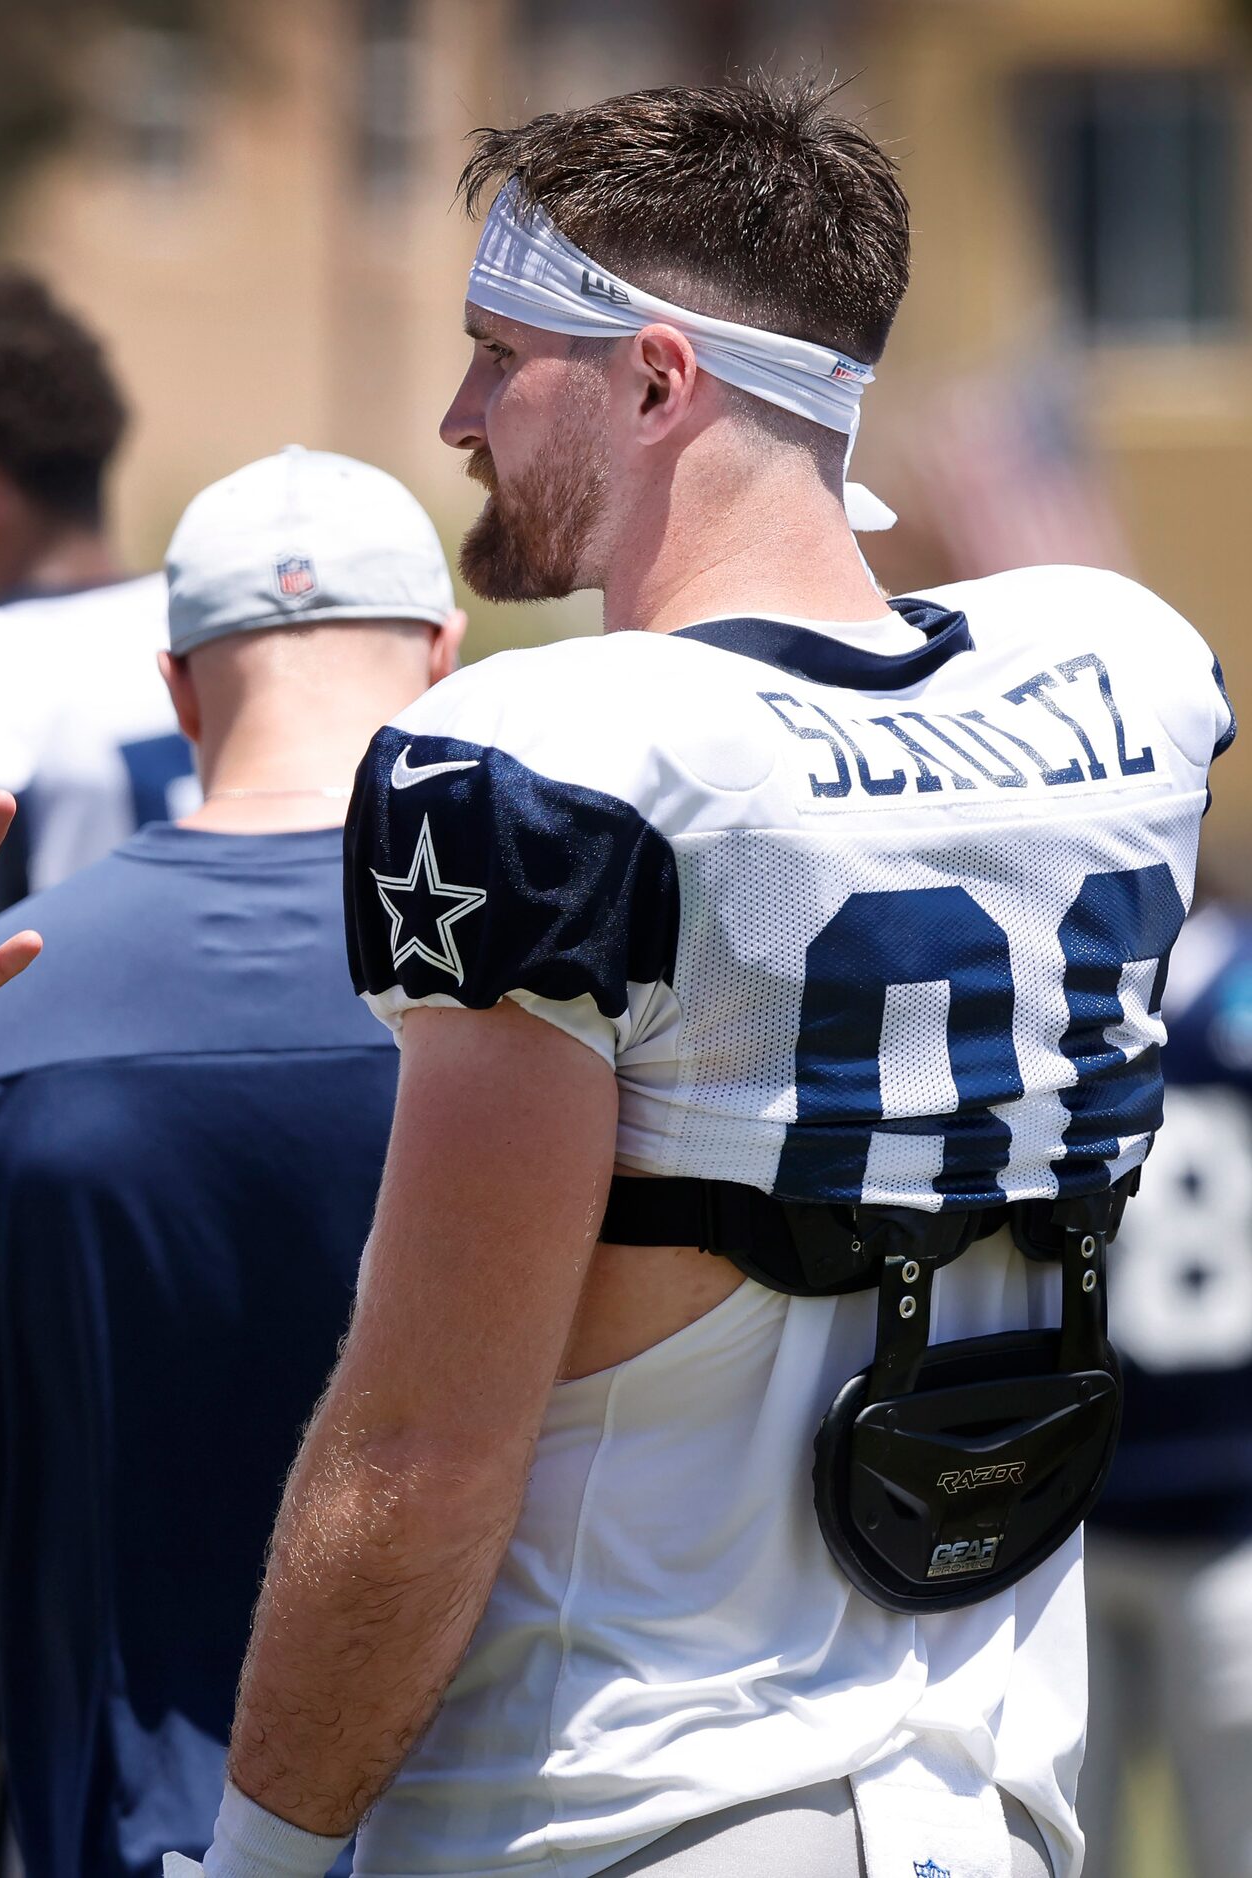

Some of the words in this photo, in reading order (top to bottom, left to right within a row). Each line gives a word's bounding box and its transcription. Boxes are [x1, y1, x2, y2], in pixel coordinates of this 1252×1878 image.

[757, 653, 1156, 799] SCHULTZ
[936, 1461, 1026, 1494] RAZOR
[930, 1537, 999, 1566] GEAR
